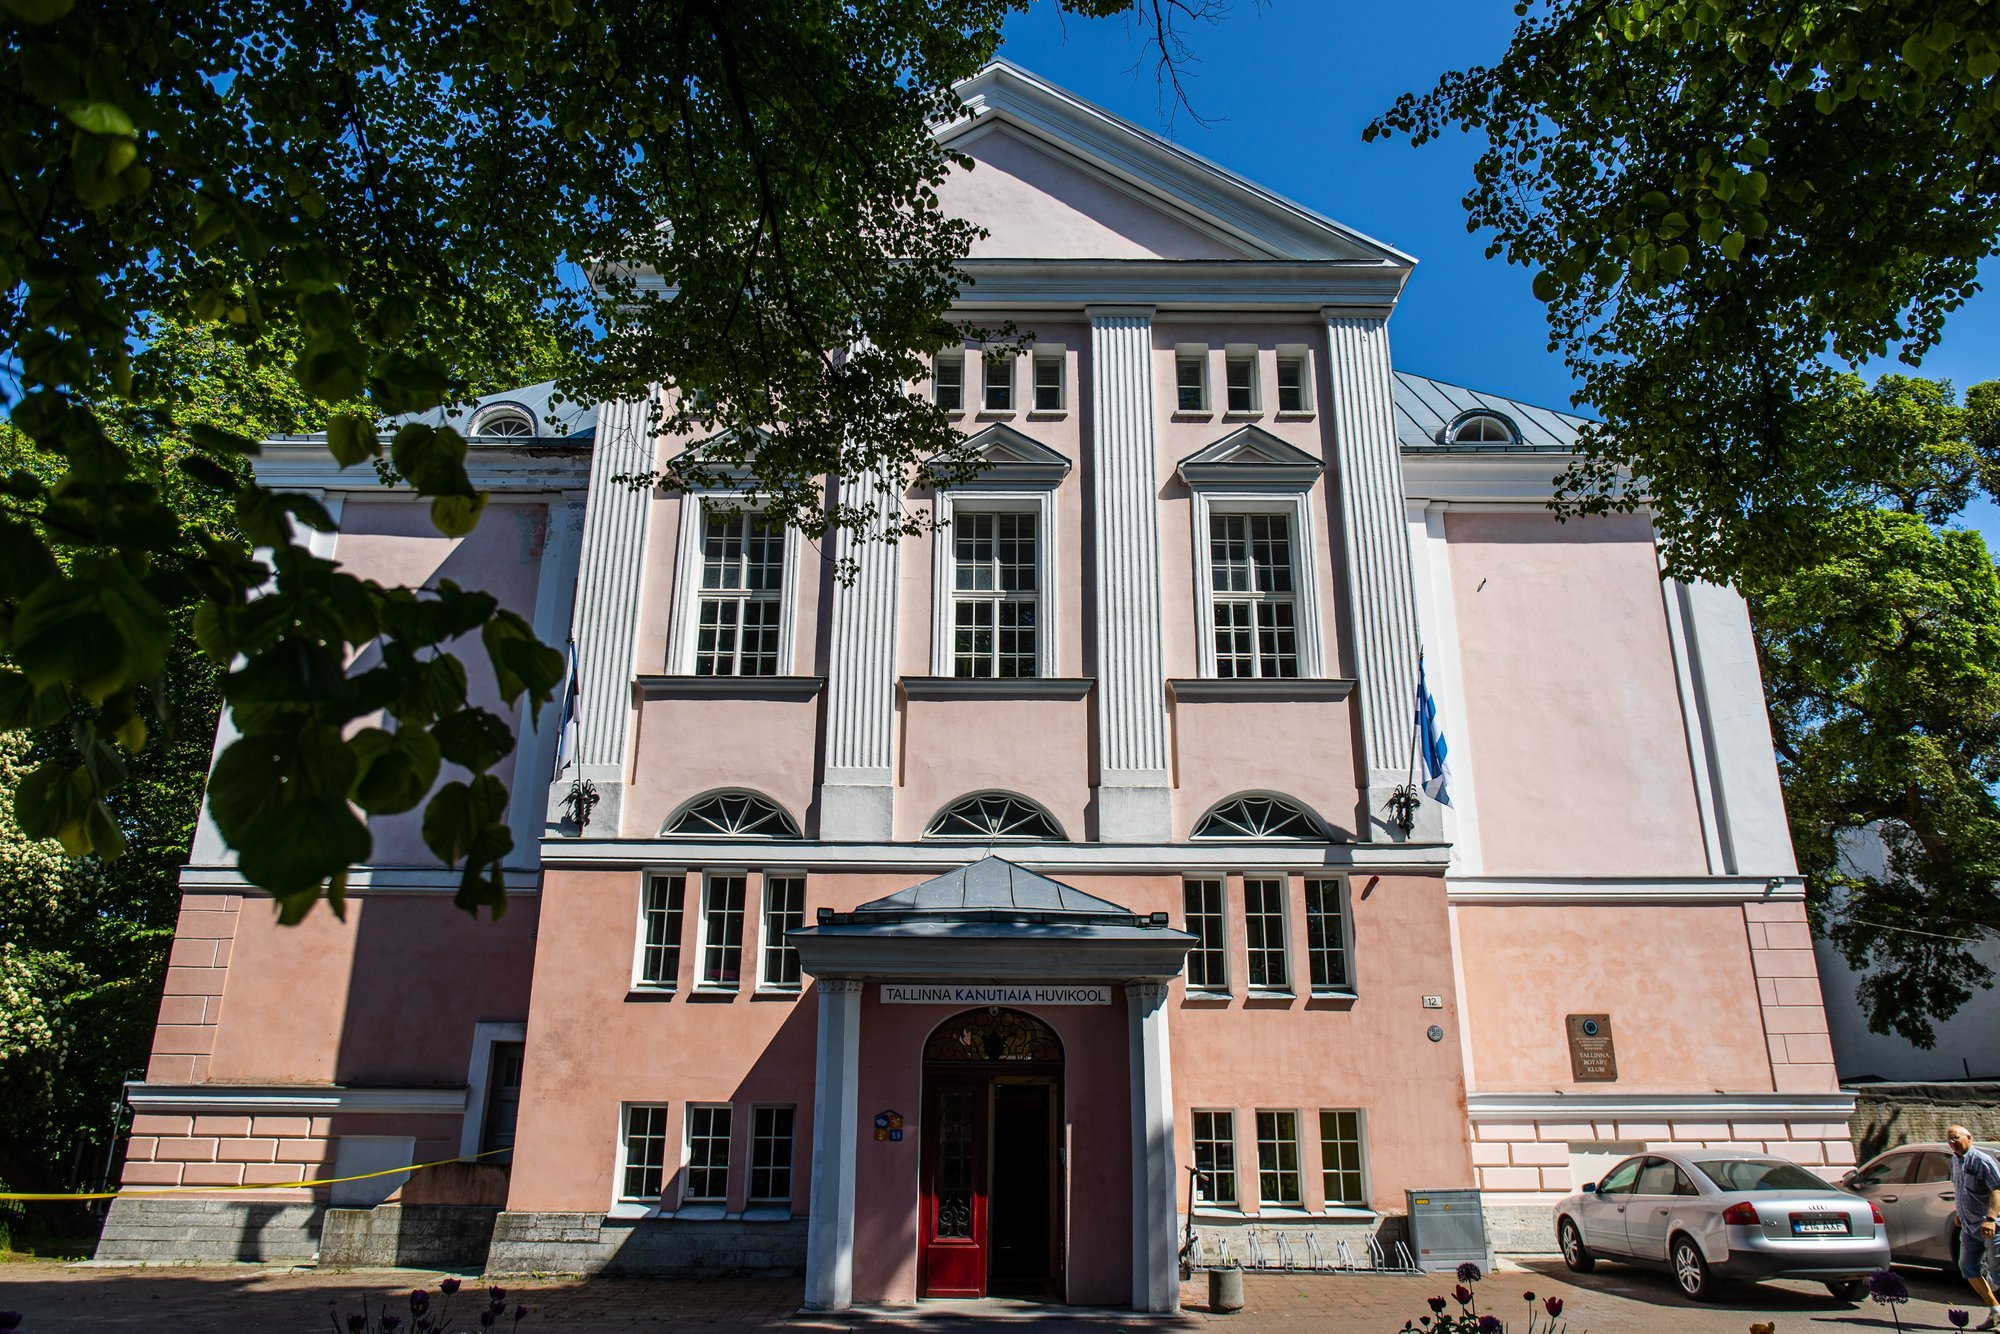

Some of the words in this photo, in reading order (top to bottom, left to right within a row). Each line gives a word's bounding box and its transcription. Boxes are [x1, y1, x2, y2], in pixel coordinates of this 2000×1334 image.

[886, 988, 952, 1001] TALLINNA
[955, 989, 1032, 1001] KANUTIAIA
[1035, 989, 1106, 1002] HUVIKOOL
[1428, 997, 1437, 1006] 12
